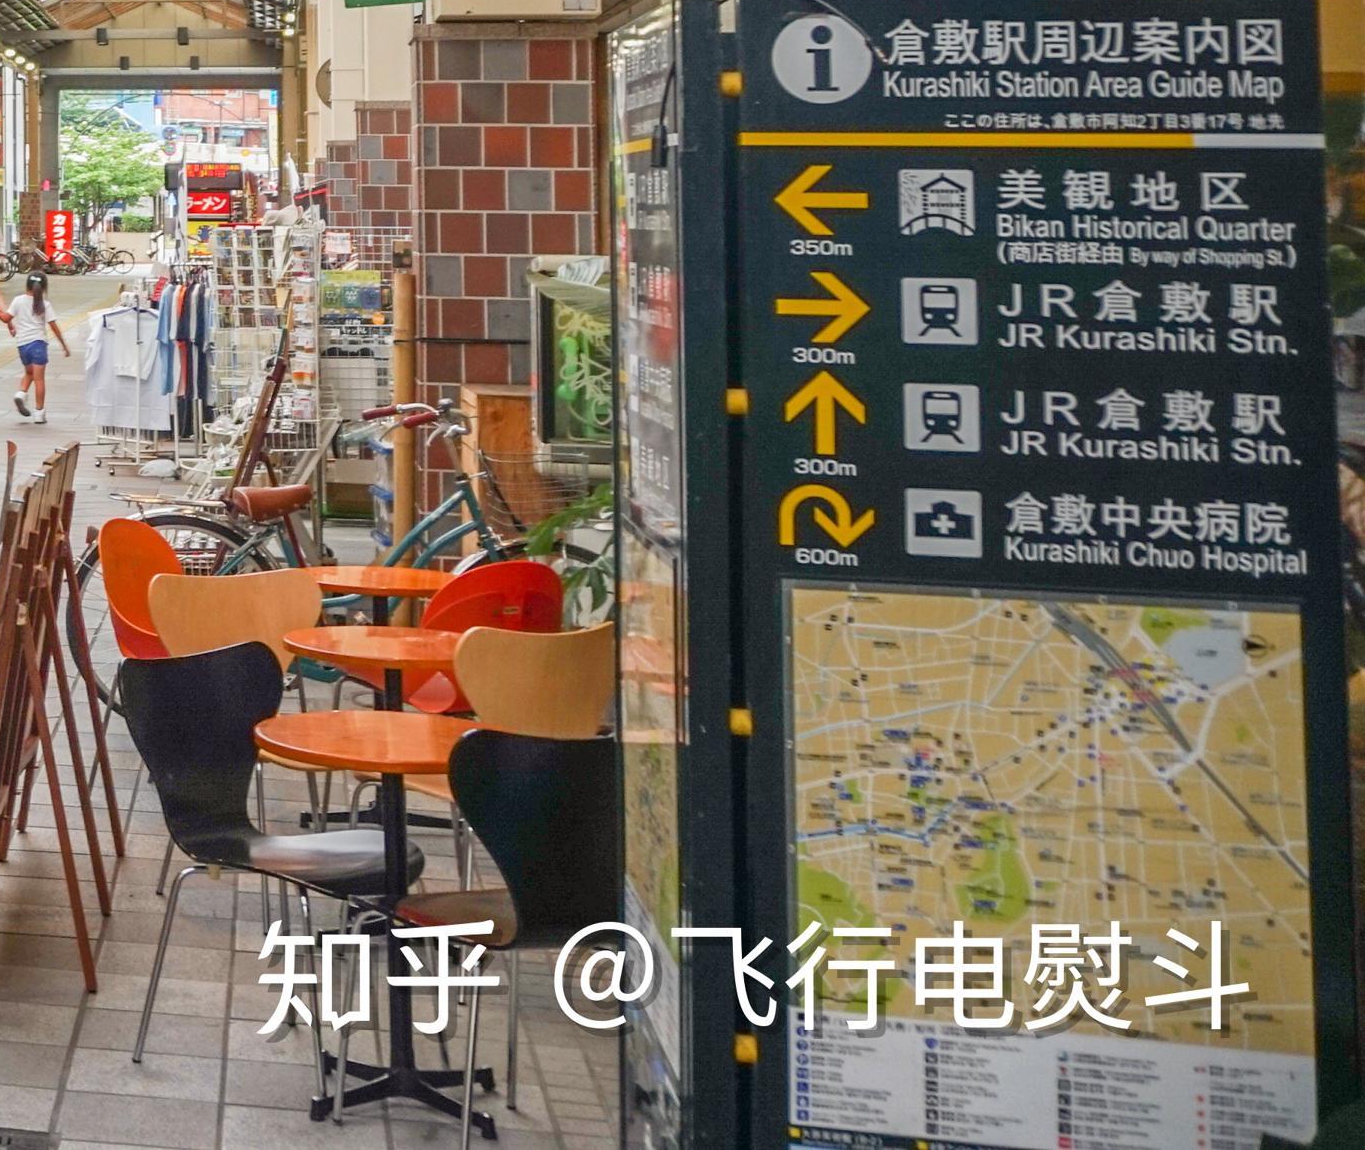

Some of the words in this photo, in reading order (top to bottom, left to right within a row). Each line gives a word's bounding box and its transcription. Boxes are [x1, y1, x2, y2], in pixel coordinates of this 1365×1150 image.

[884, 17, 1284, 67] 倉敷駅周辺案内図
[883, 69, 989, 98] Kurashiki
[996, 70, 1079, 98] Station
[1084, 71, 1142, 98] Area
[1148, 70, 1223, 98] Guide
[1229, 71, 1285, 104] Map
[187, 196, 227, 211] ラーメン
[997, 169, 1249, 211] 美観地区
[996, 214, 1065, 239] Bikan
[1072, 215, 1188, 241] Historical
[1195, 216, 1295, 243] Quarter
[790, 239, 853, 257] 350m
[997, 244, 1124, 266] (商店街経由
[1130, 247, 1151, 266] By
[1153, 250, 1180, 267] way
[1182, 248, 1196, 264] of
[1200, 249, 1265, 269] Shopping
[998, 280, 1282, 325] JR倉敷駅
[792, 347, 856, 365] 300m
[998, 324, 1046, 349] JR
[1055, 324, 1216, 352] Kurashiki
[1227, 328, 1299, 356] Stn.
[1000, 387, 1287, 437] JR倉敷駅
[1000, 431, 1047, 456] JR
[1058, 432, 1219, 462] Kurashiki
[1230, 438, 1302, 466] Stn.
[794, 459, 857, 477] 300m
[1005, 492, 1292, 546] 倉敷中央病院
[795, 549, 859, 567] 600m
[1004, 537, 1120, 567] Kurashiki
[1132, 541, 1195, 571] Chuo
[1202, 544, 1308, 577] Hospital
